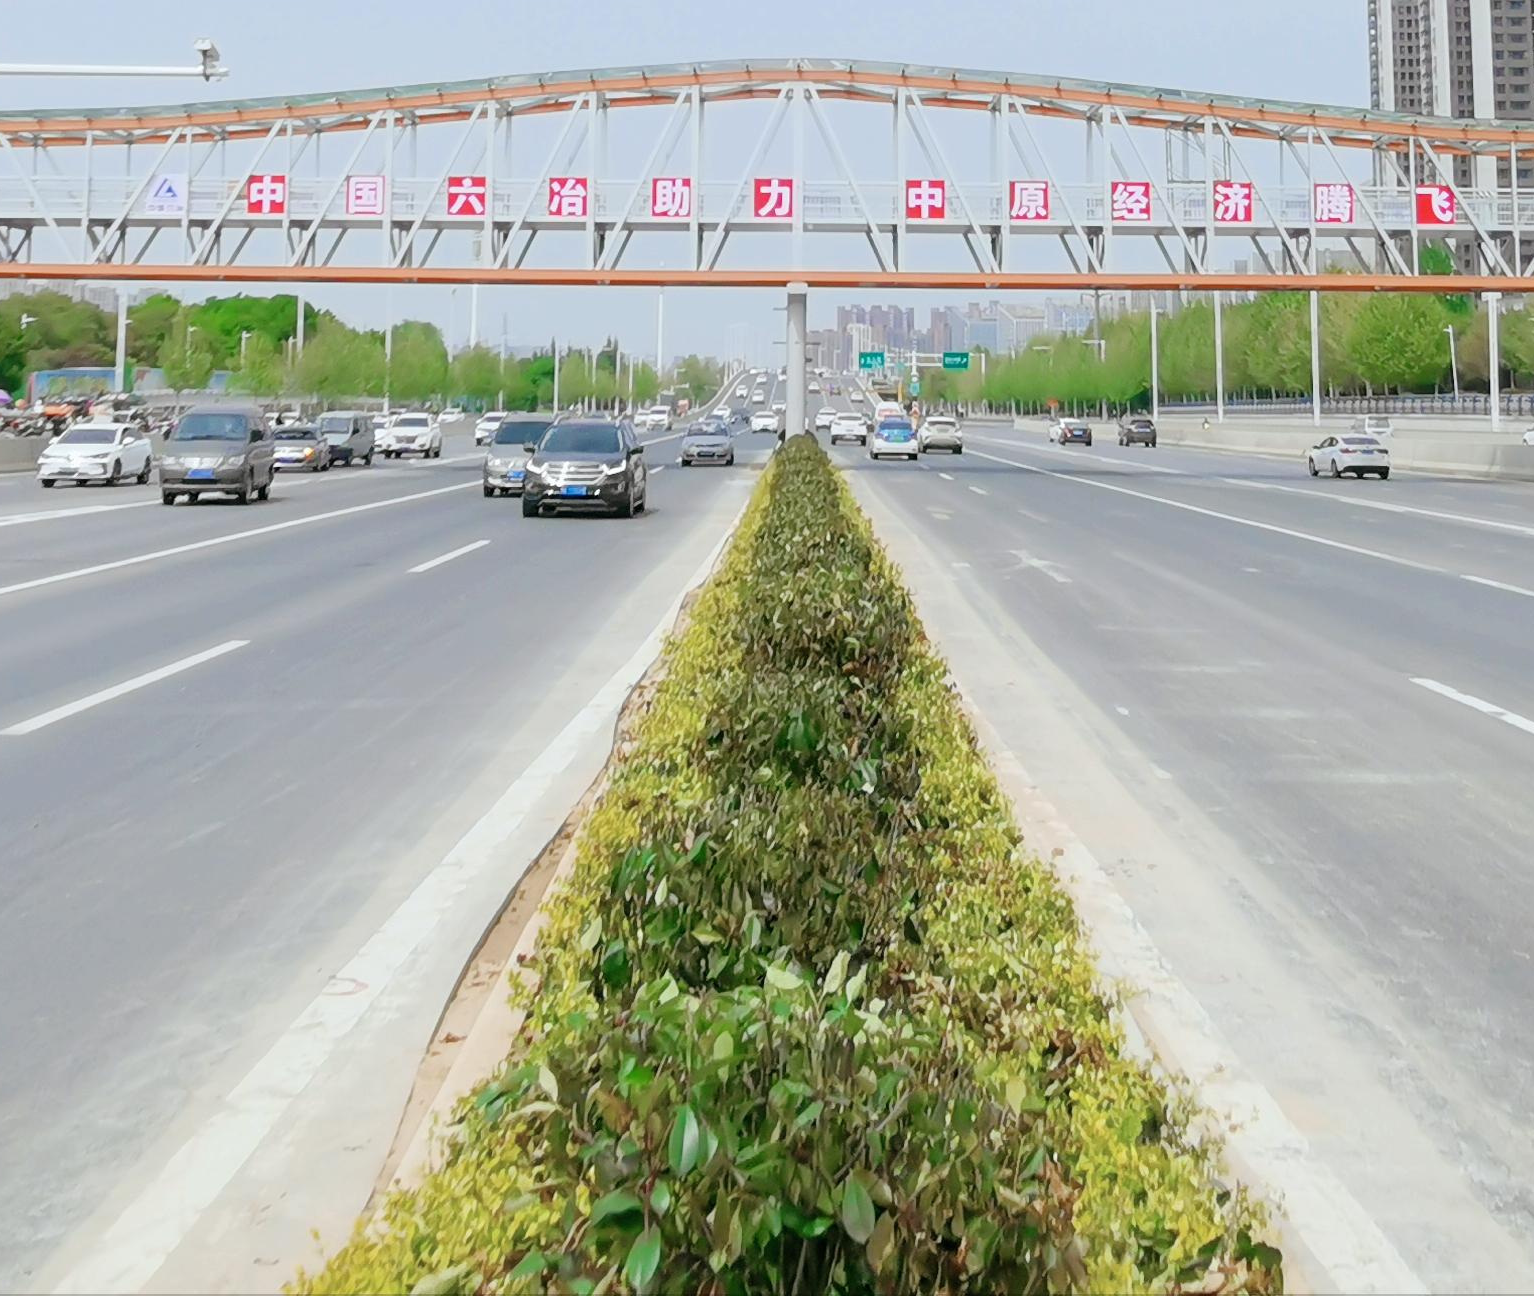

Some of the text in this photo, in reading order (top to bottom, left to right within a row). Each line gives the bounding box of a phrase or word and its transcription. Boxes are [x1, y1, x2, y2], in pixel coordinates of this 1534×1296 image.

[248, 175, 1454, 223] 中国六冶助力 中原经济腾飞
